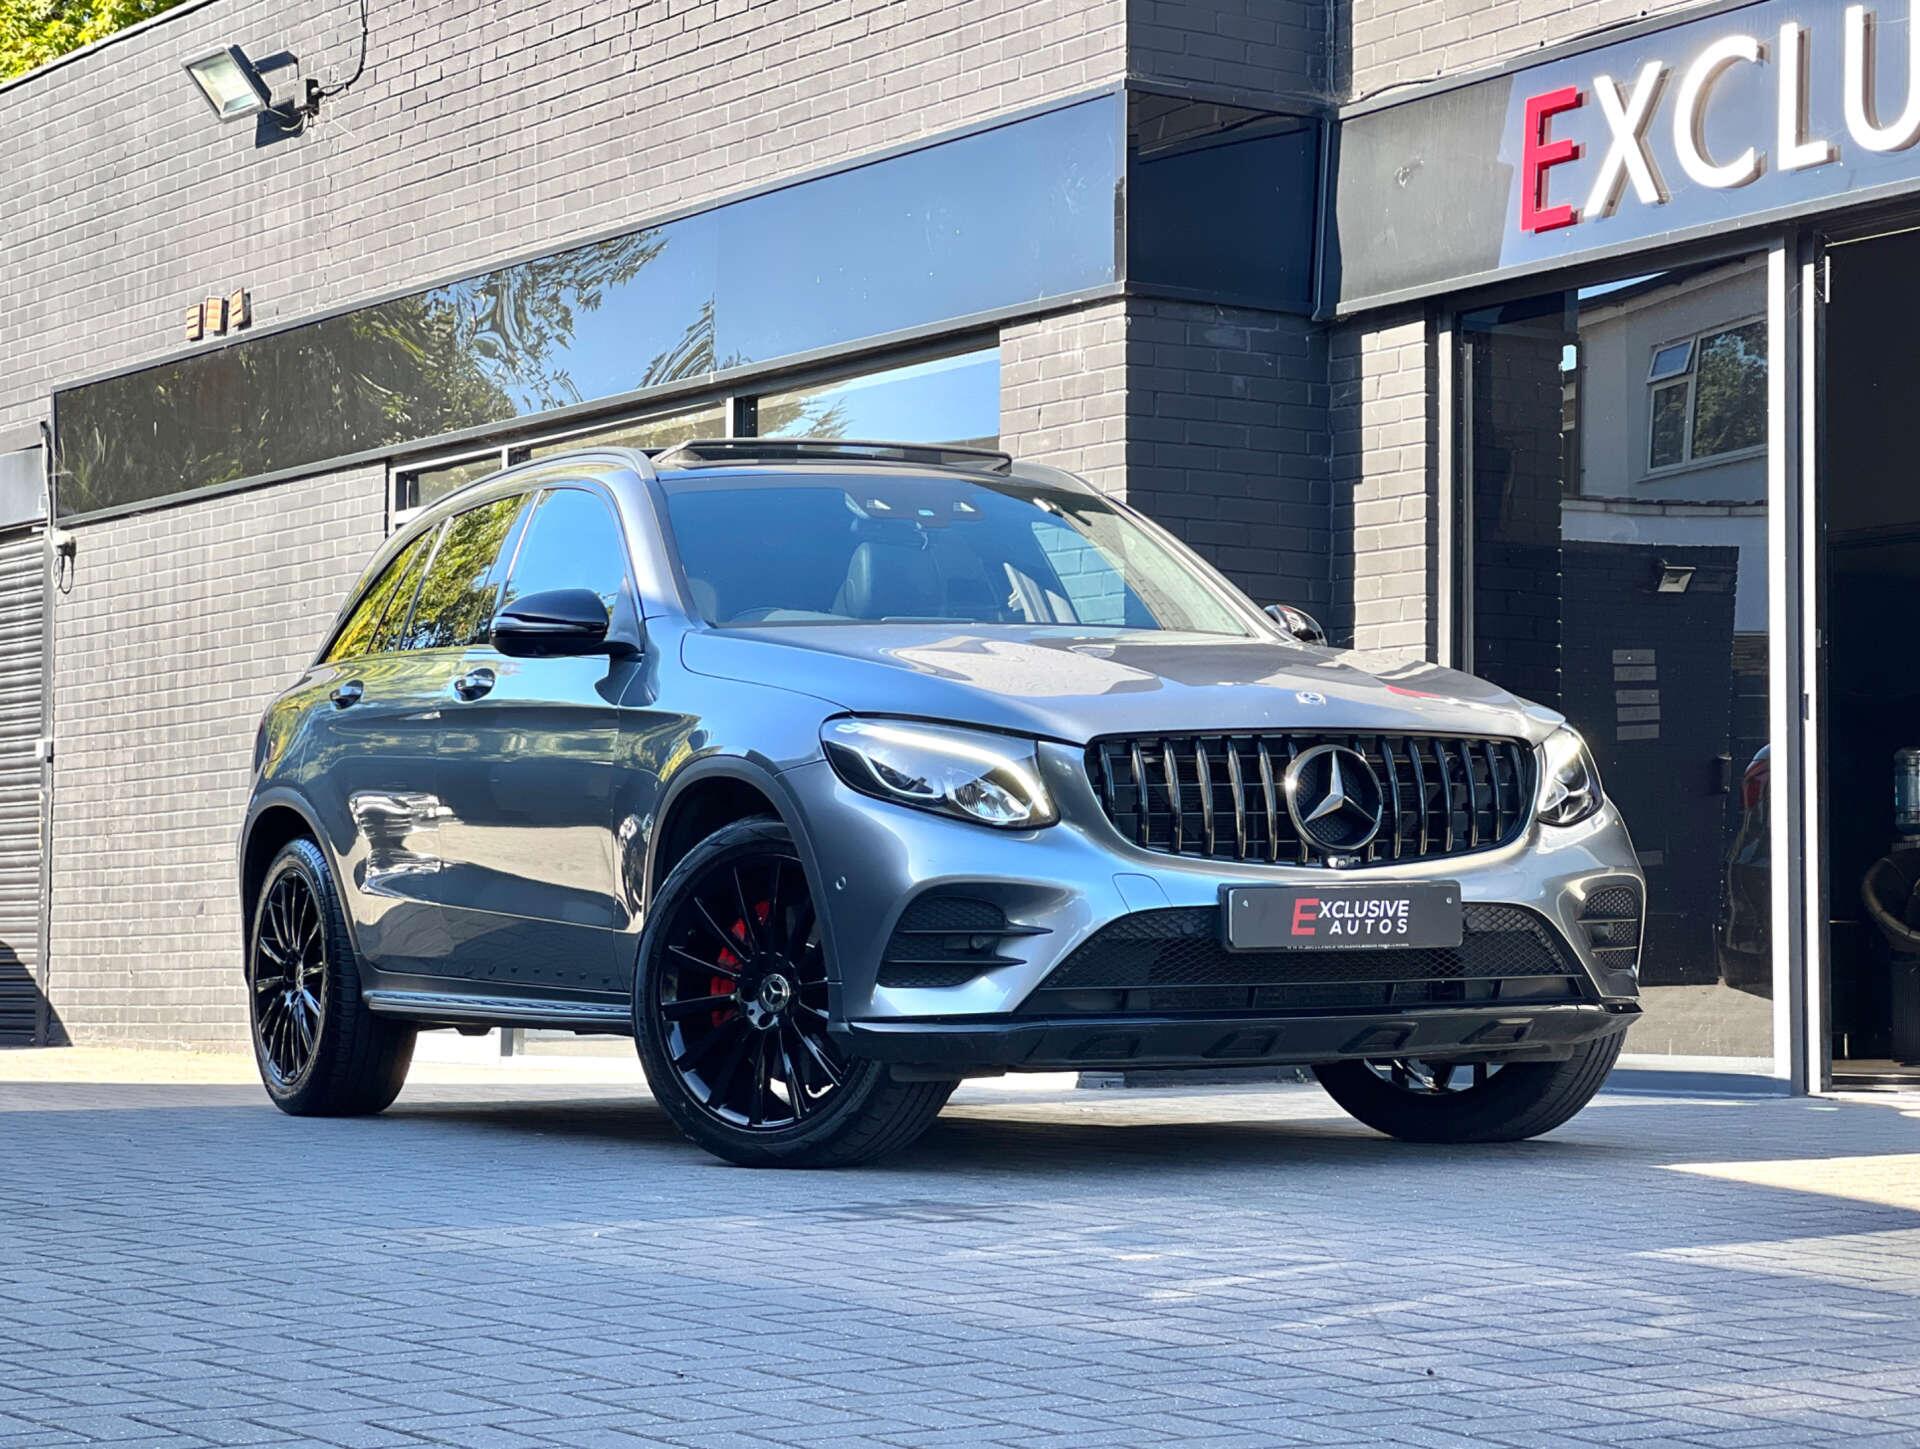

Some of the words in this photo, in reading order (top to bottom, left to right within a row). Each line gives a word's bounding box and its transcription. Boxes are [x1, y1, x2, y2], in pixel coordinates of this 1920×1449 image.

[1521, 2, 1920, 233] EXCLU
[1291, 898, 1410, 935] EXCLUSIVE
[1329, 918, 1408, 935] AUTOS
